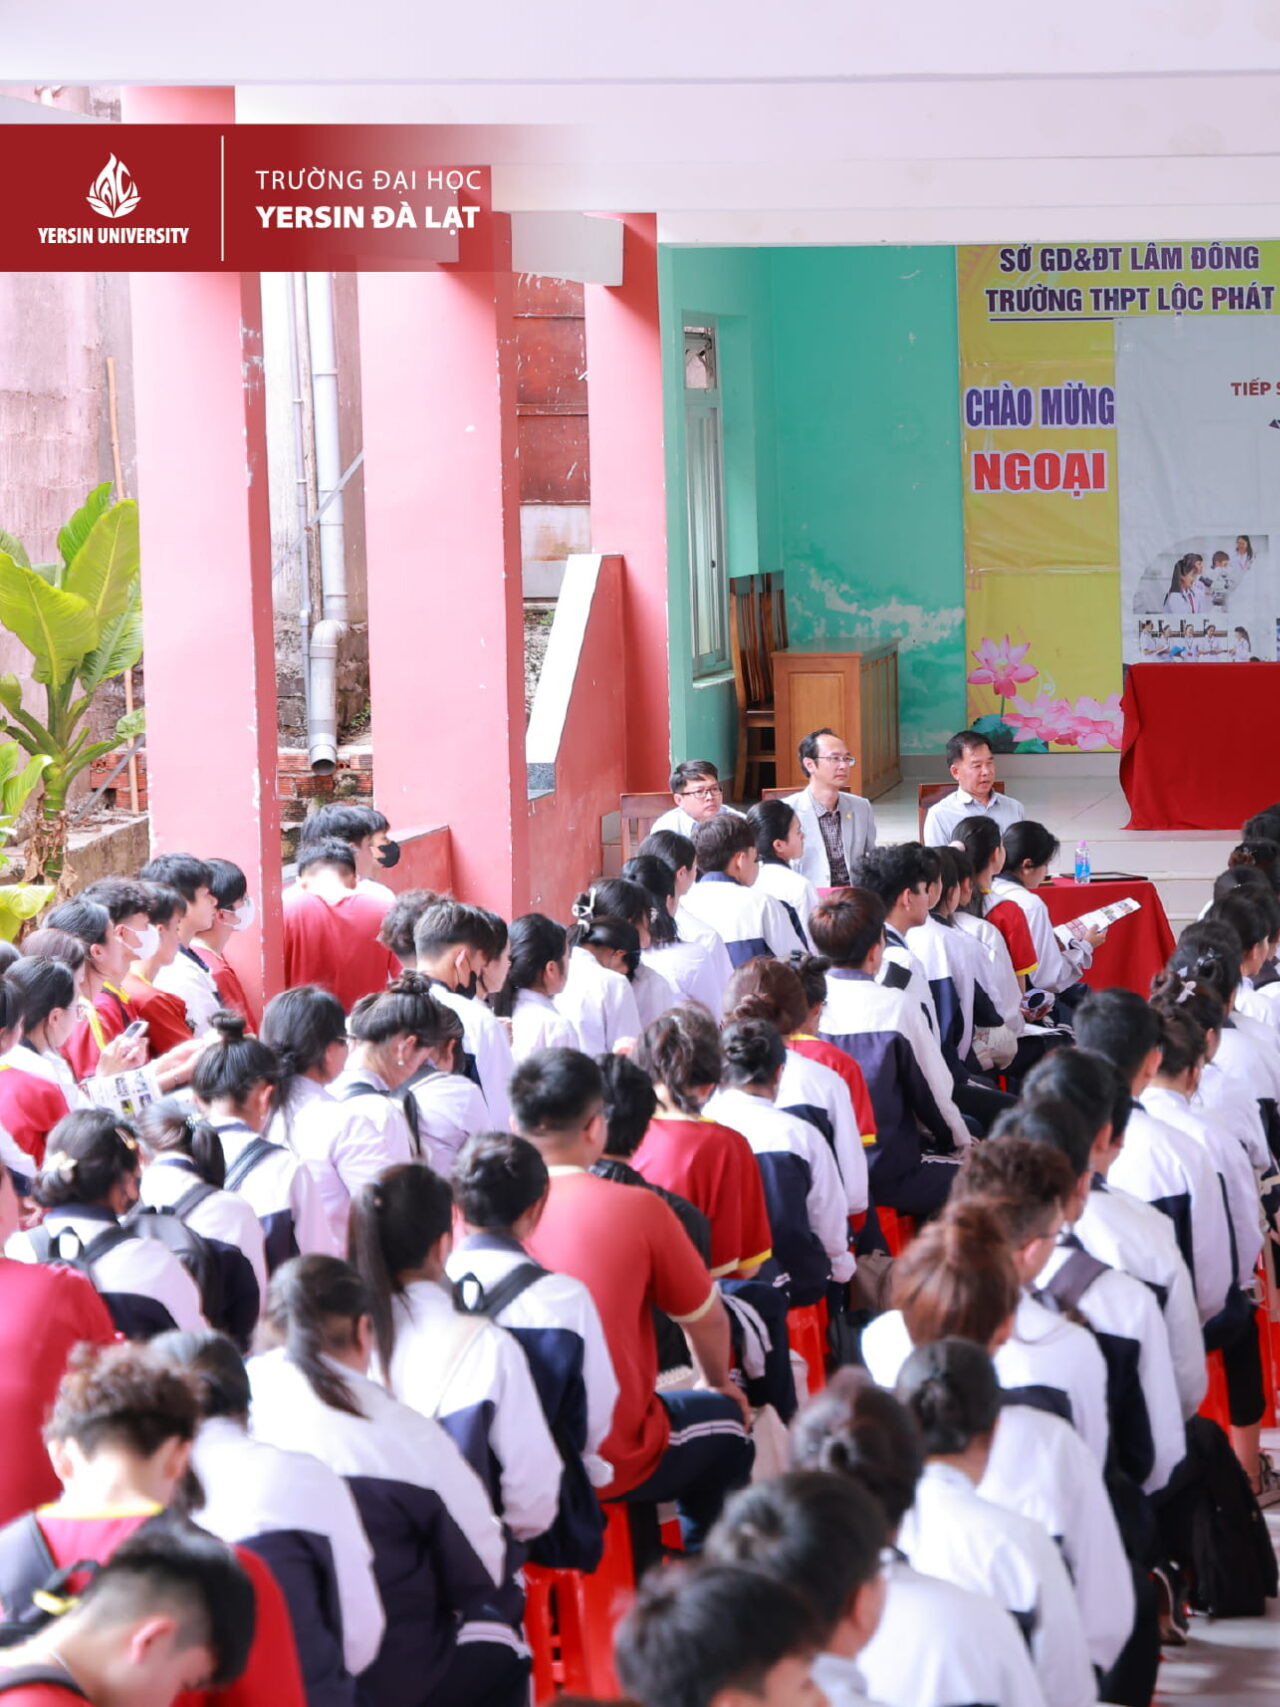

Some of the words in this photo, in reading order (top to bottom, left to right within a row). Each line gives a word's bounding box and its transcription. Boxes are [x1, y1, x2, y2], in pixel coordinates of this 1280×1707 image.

[1000, 243, 1032, 272] SỞ
[1040, 247, 1122, 272] GD&ĐT
[1131, 242, 1182, 271] LÂM
[1191, 240, 1260, 270] ĐỒNG
[986, 283, 1082, 313] TRƯỜNG
[1090, 287, 1150, 311] THPT
[1158, 283, 1203, 316] LỘC
[1212, 282, 1275, 310] PHÁT
[1231, 377, 1271, 396] TIẾP
[966, 383, 1032, 427] CHÀO
[1041, 382, 1114, 425] MỪNG
[974, 453, 1105, 497] NGOẠI
